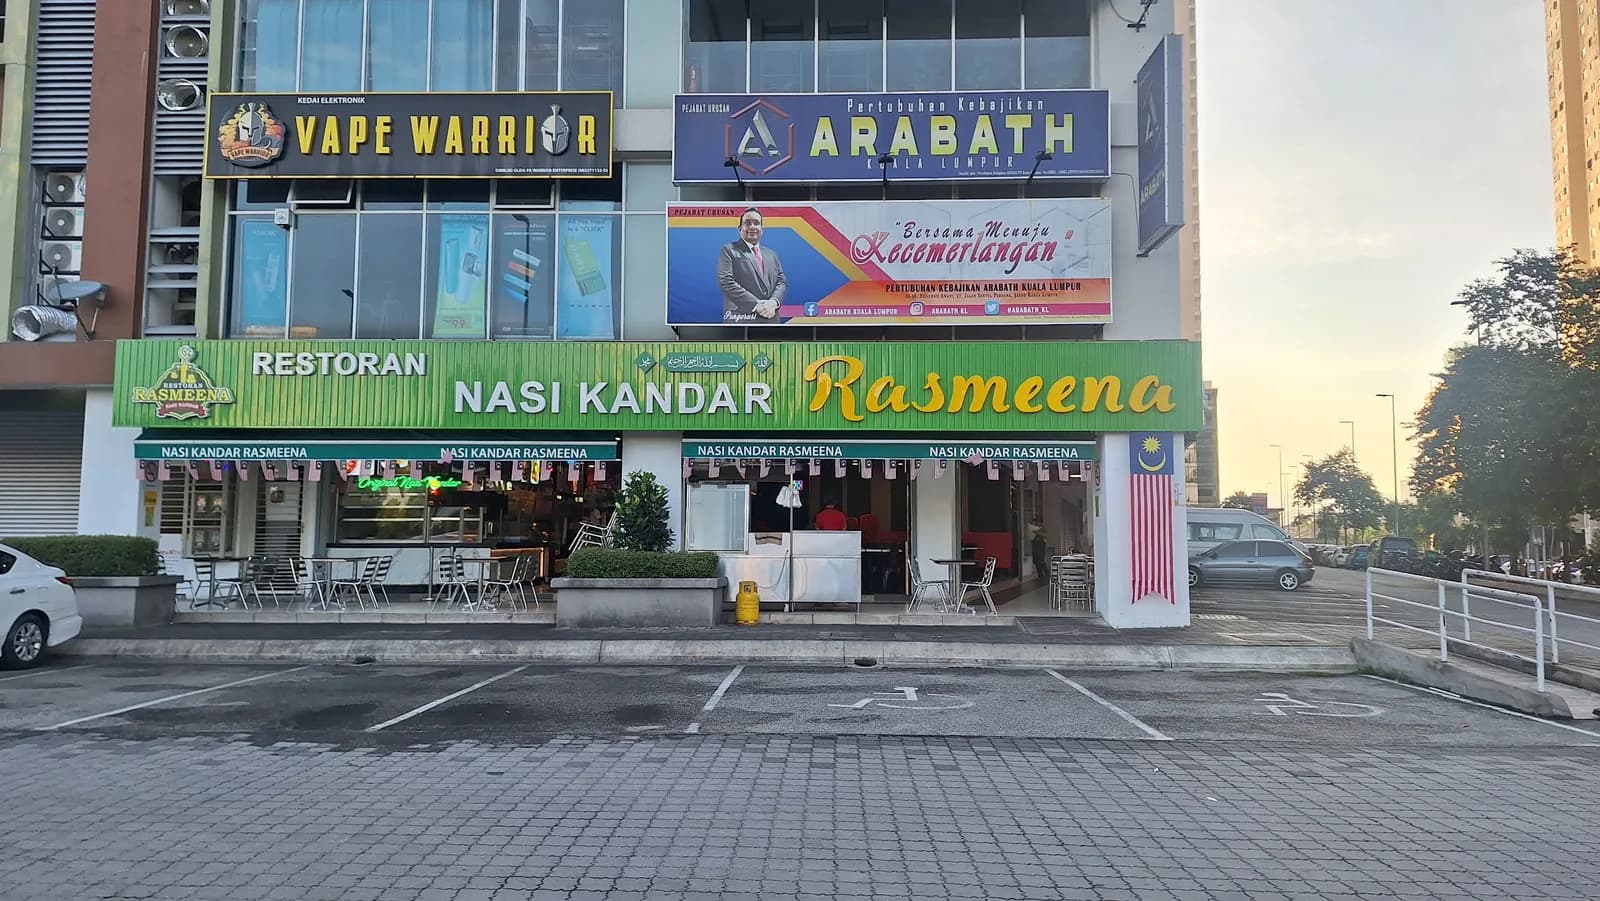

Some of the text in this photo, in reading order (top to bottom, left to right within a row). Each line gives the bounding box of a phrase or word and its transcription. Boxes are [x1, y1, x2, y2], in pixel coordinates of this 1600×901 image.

[681, 103, 730, 113] PEJABAT URUSAN
[847, 96, 1043, 113] Pertubuhan Kebajikan
[295, 115, 392, 155] VAPE
[809, 112, 1074, 157] ARABATH
[941, 156, 1014, 169] LUMPUR
[674, 208, 736, 216] PEJABAT URUSAN
[984, 219, 1050, 242] Menuju
[885, 281, 1082, 293] PERTUBUHAN KEBAJIKAN ARABATH KUALA LUMPUR
[931, 307, 959, 315] ARABATH
[252, 351, 428, 377] RESTORAN
[135, 388, 230, 402] RASMEENA
[804, 354, 1176, 423] Rasmeena
[454, 380, 774, 415] NASI KANDAR
[161, 447, 308, 458] NASI KANDAR RASMEENA
[440, 447, 588, 459] NASI KANDAR RASMEENA
[698, 445, 843, 457] NASI KANDAR RASMEENA
[929, 446, 1079, 458] NASI KANDAR RASMEENA
[423, 475, 462, 490] Kndar
